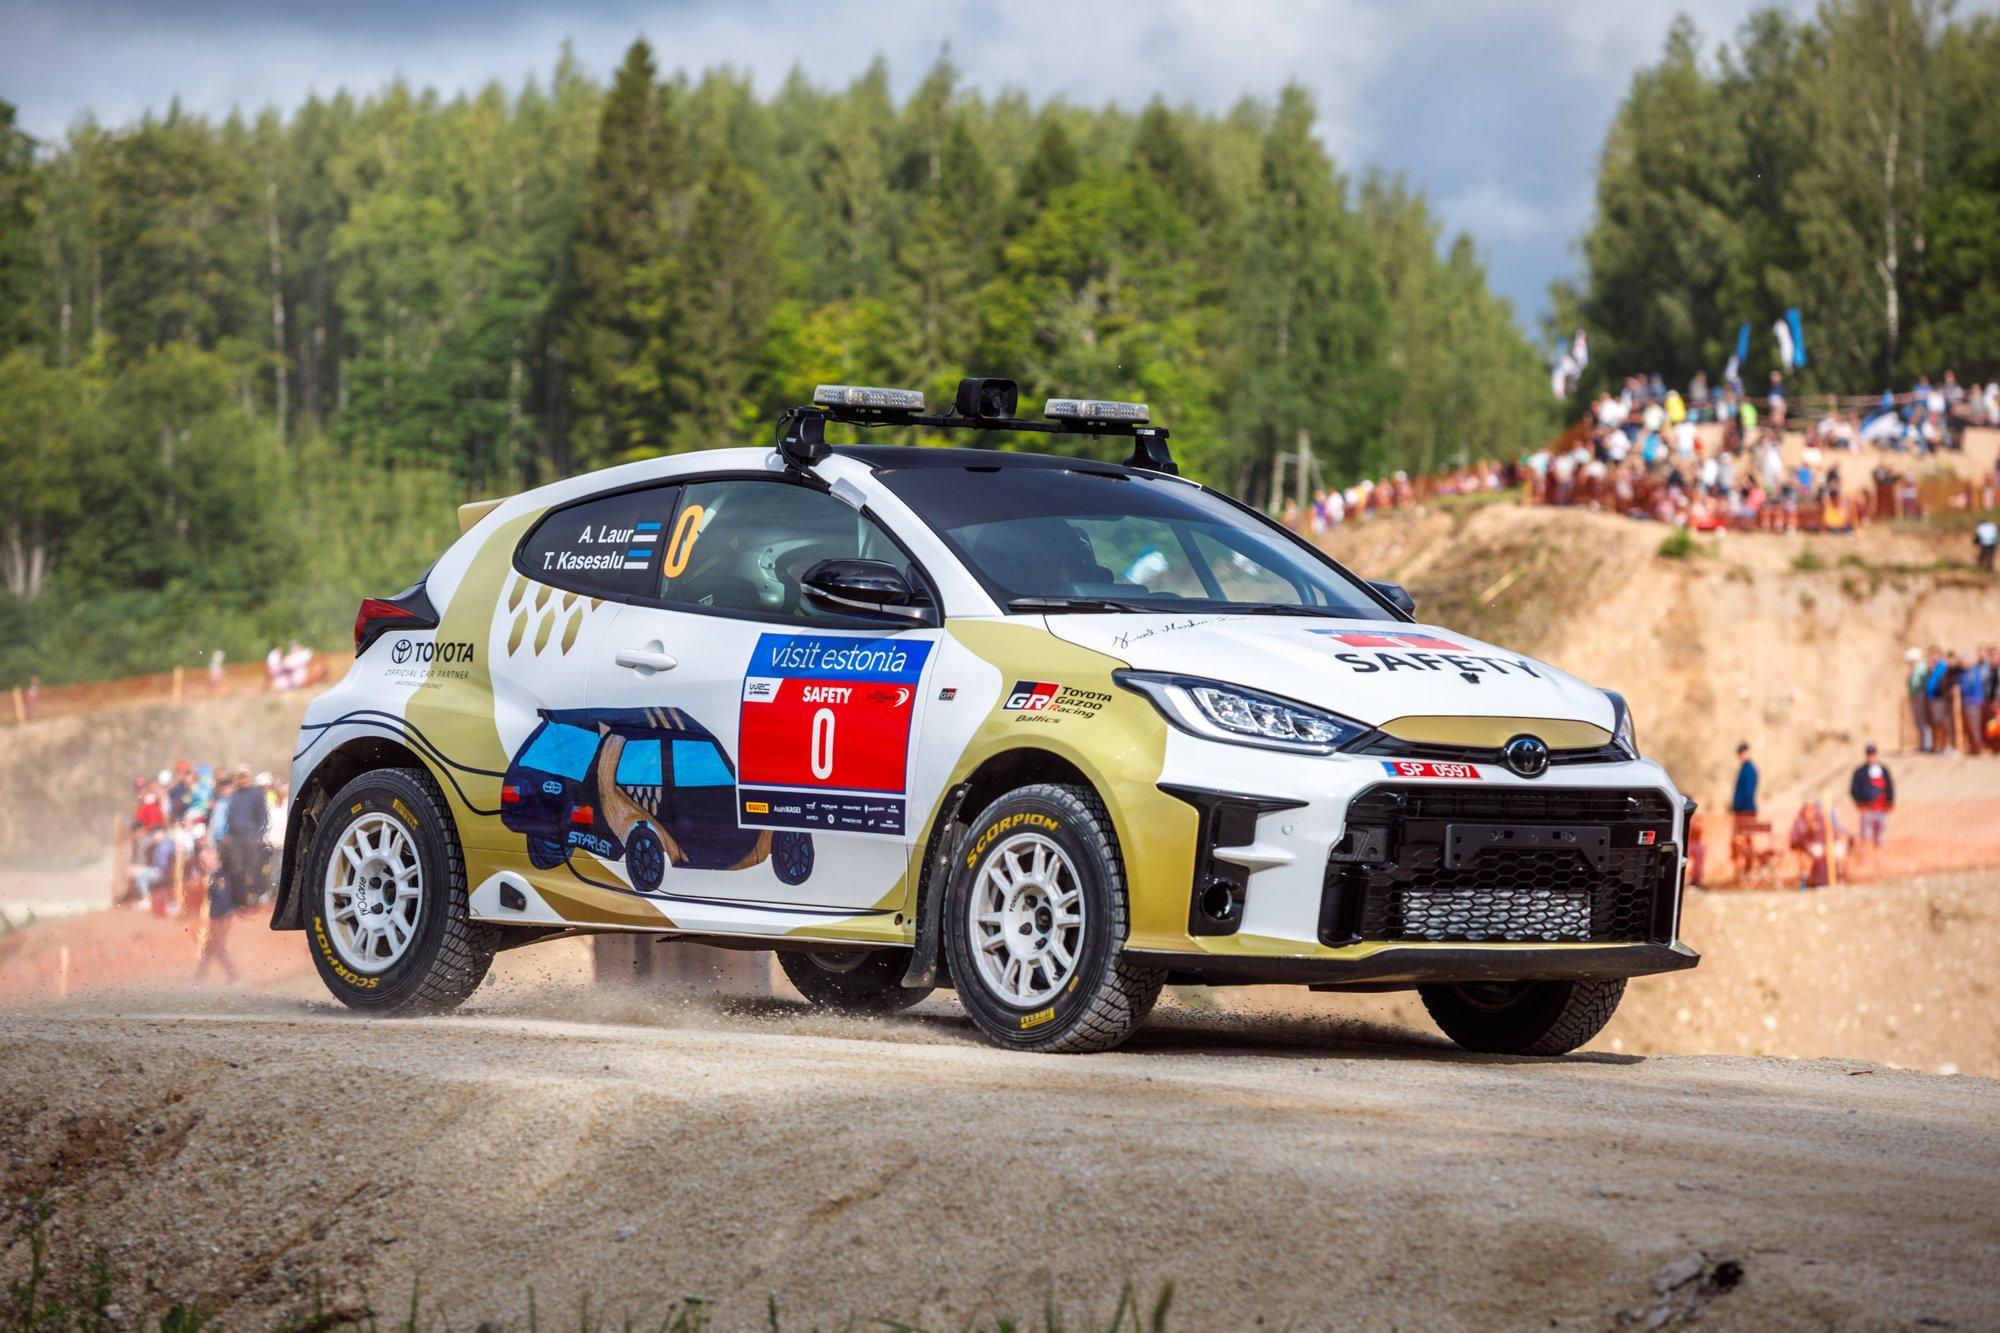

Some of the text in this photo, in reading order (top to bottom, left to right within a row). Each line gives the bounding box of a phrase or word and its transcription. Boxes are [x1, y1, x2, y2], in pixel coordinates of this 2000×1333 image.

[578, 525, 634, 543] A. Laur
[663, 505, 704, 578] 0
[543, 551, 625, 570] T. Kasesalu
[415, 642, 474, 663] TOYOTA
[771, 641, 908, 673] visit estonia
[384, 669, 470, 680] OFFICIAL CAR PARTNER
[1334, 652, 1542, 678] SAFETY
[749, 683, 771, 691] WRC
[802, 685, 853, 704] SAFETY
[1062, 686, 1113, 702] TOYOTA
[1006, 693, 1050, 709] GR
[1055, 696, 1103, 710] GAZOO
[1015, 714, 1062, 724] Baltics
[1048, 704, 1095, 719] Racing
[811, 707, 836, 780] 0
[1400, 762, 1425, 776] SP
[1431, 764, 1471, 777] 0597
[568, 830, 612, 856] STARLET
[966, 813, 1060, 869] SCORPION
[313, 916, 380, 988] SCORPION
